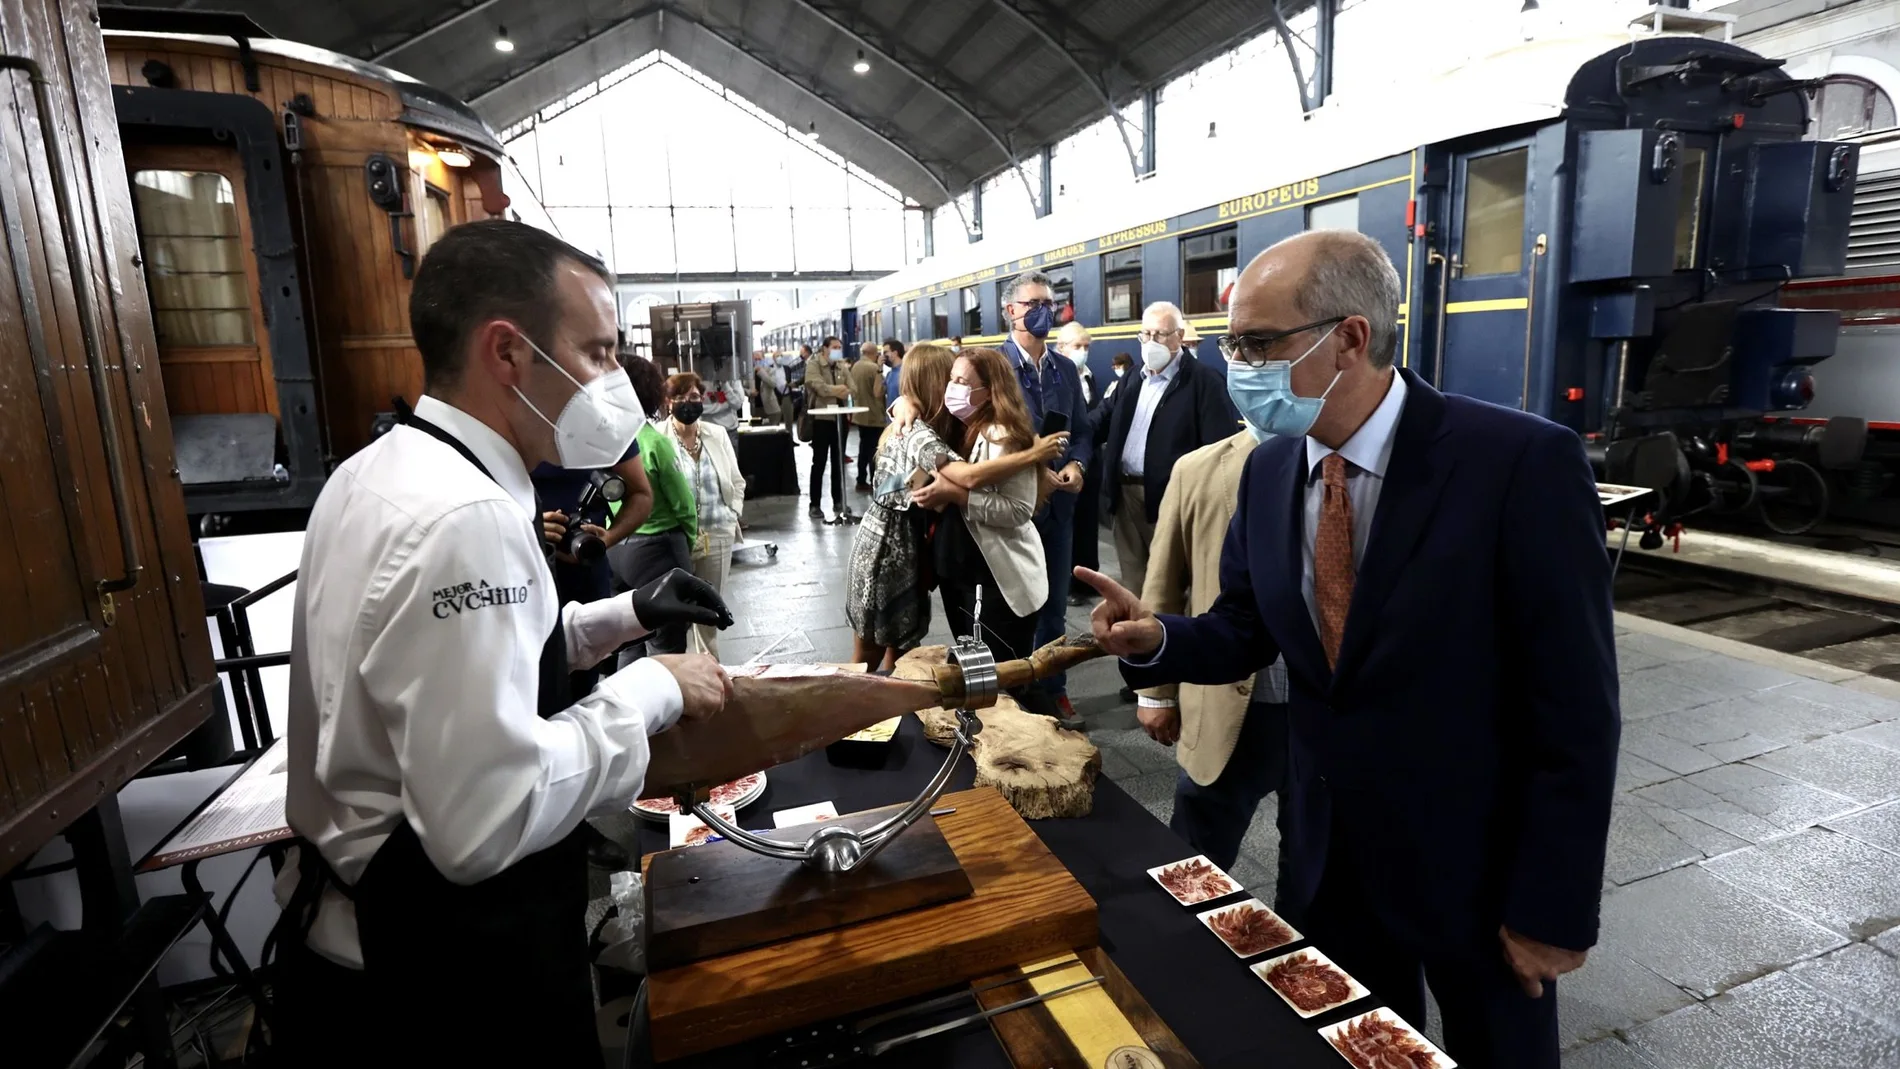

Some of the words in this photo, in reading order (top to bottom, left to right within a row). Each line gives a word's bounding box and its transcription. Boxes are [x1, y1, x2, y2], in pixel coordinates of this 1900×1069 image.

[1098, 219, 1168, 249] EXPRESSOS
[1218, 176, 1320, 219] EUROPEUS
[432, 582, 476, 602] MEJOR
[479, 579, 491, 589] A
[254, 828, 292, 841] CION
